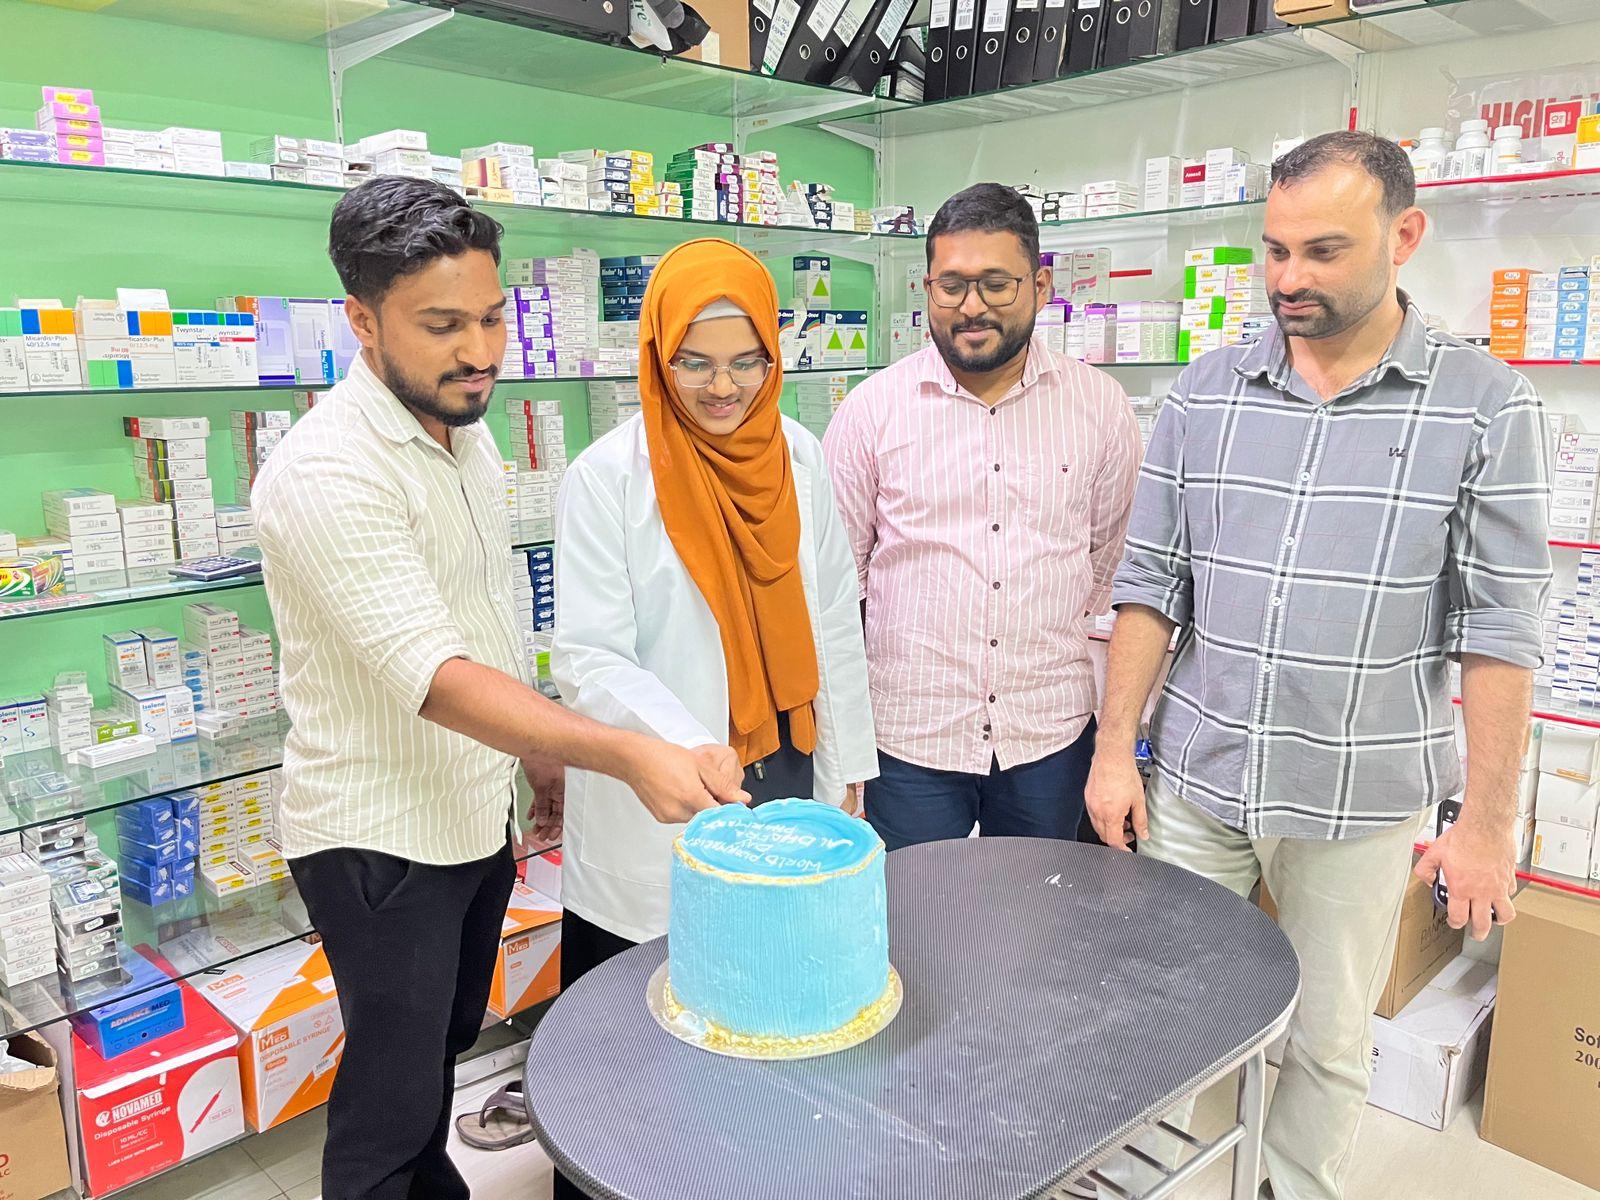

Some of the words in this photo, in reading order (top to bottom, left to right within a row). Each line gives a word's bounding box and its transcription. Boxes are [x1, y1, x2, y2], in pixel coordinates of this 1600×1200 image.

[110, 1007, 151, 1029] ADVANCE
[151, 999, 171, 1013] MED
[111, 1092, 164, 1122] NOVAMED
[94, 1118, 139, 1141] Disposable
[141, 1106, 172, 1124] Syringe
